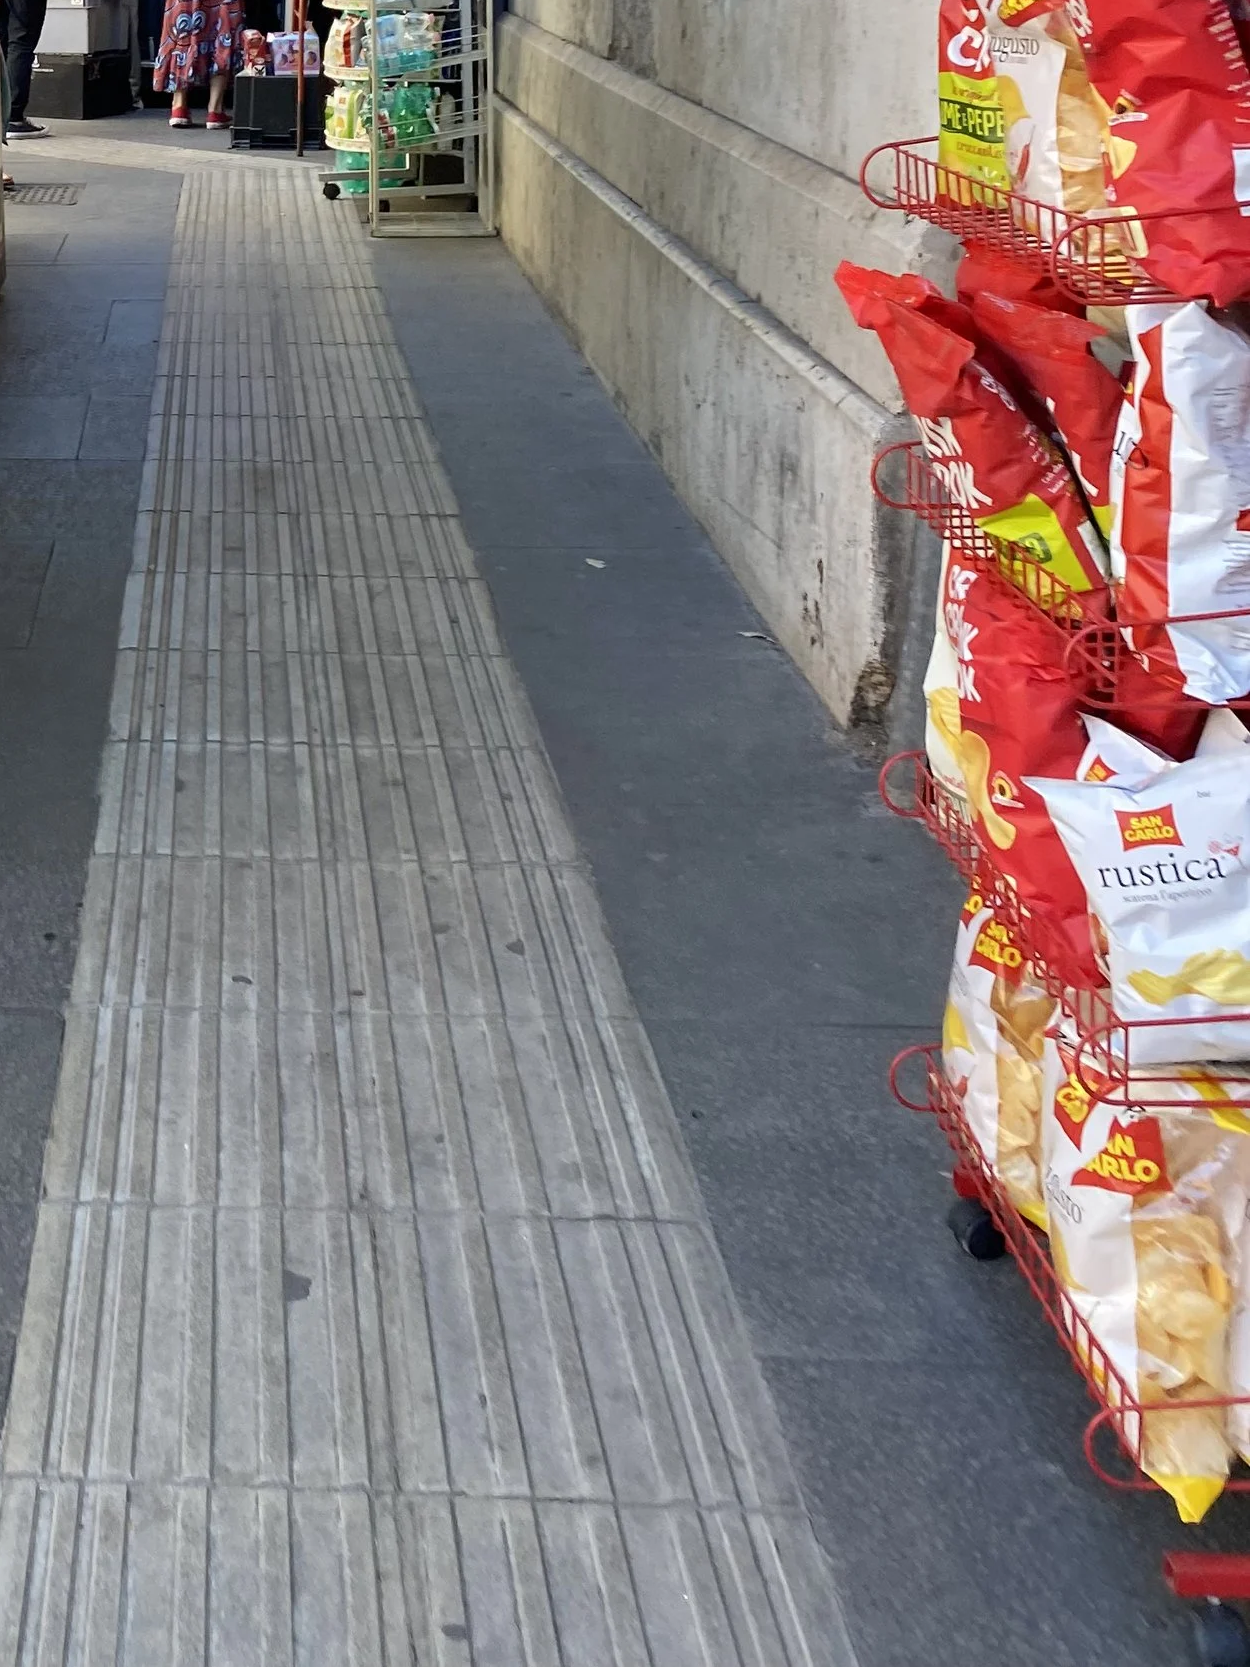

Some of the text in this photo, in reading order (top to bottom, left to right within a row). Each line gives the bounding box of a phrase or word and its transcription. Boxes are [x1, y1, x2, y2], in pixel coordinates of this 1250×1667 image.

[1130, 815, 1162, 829] SAN
[1123, 826, 1175, 843] CARLO
[1097, 852, 1227, 889] rustica
